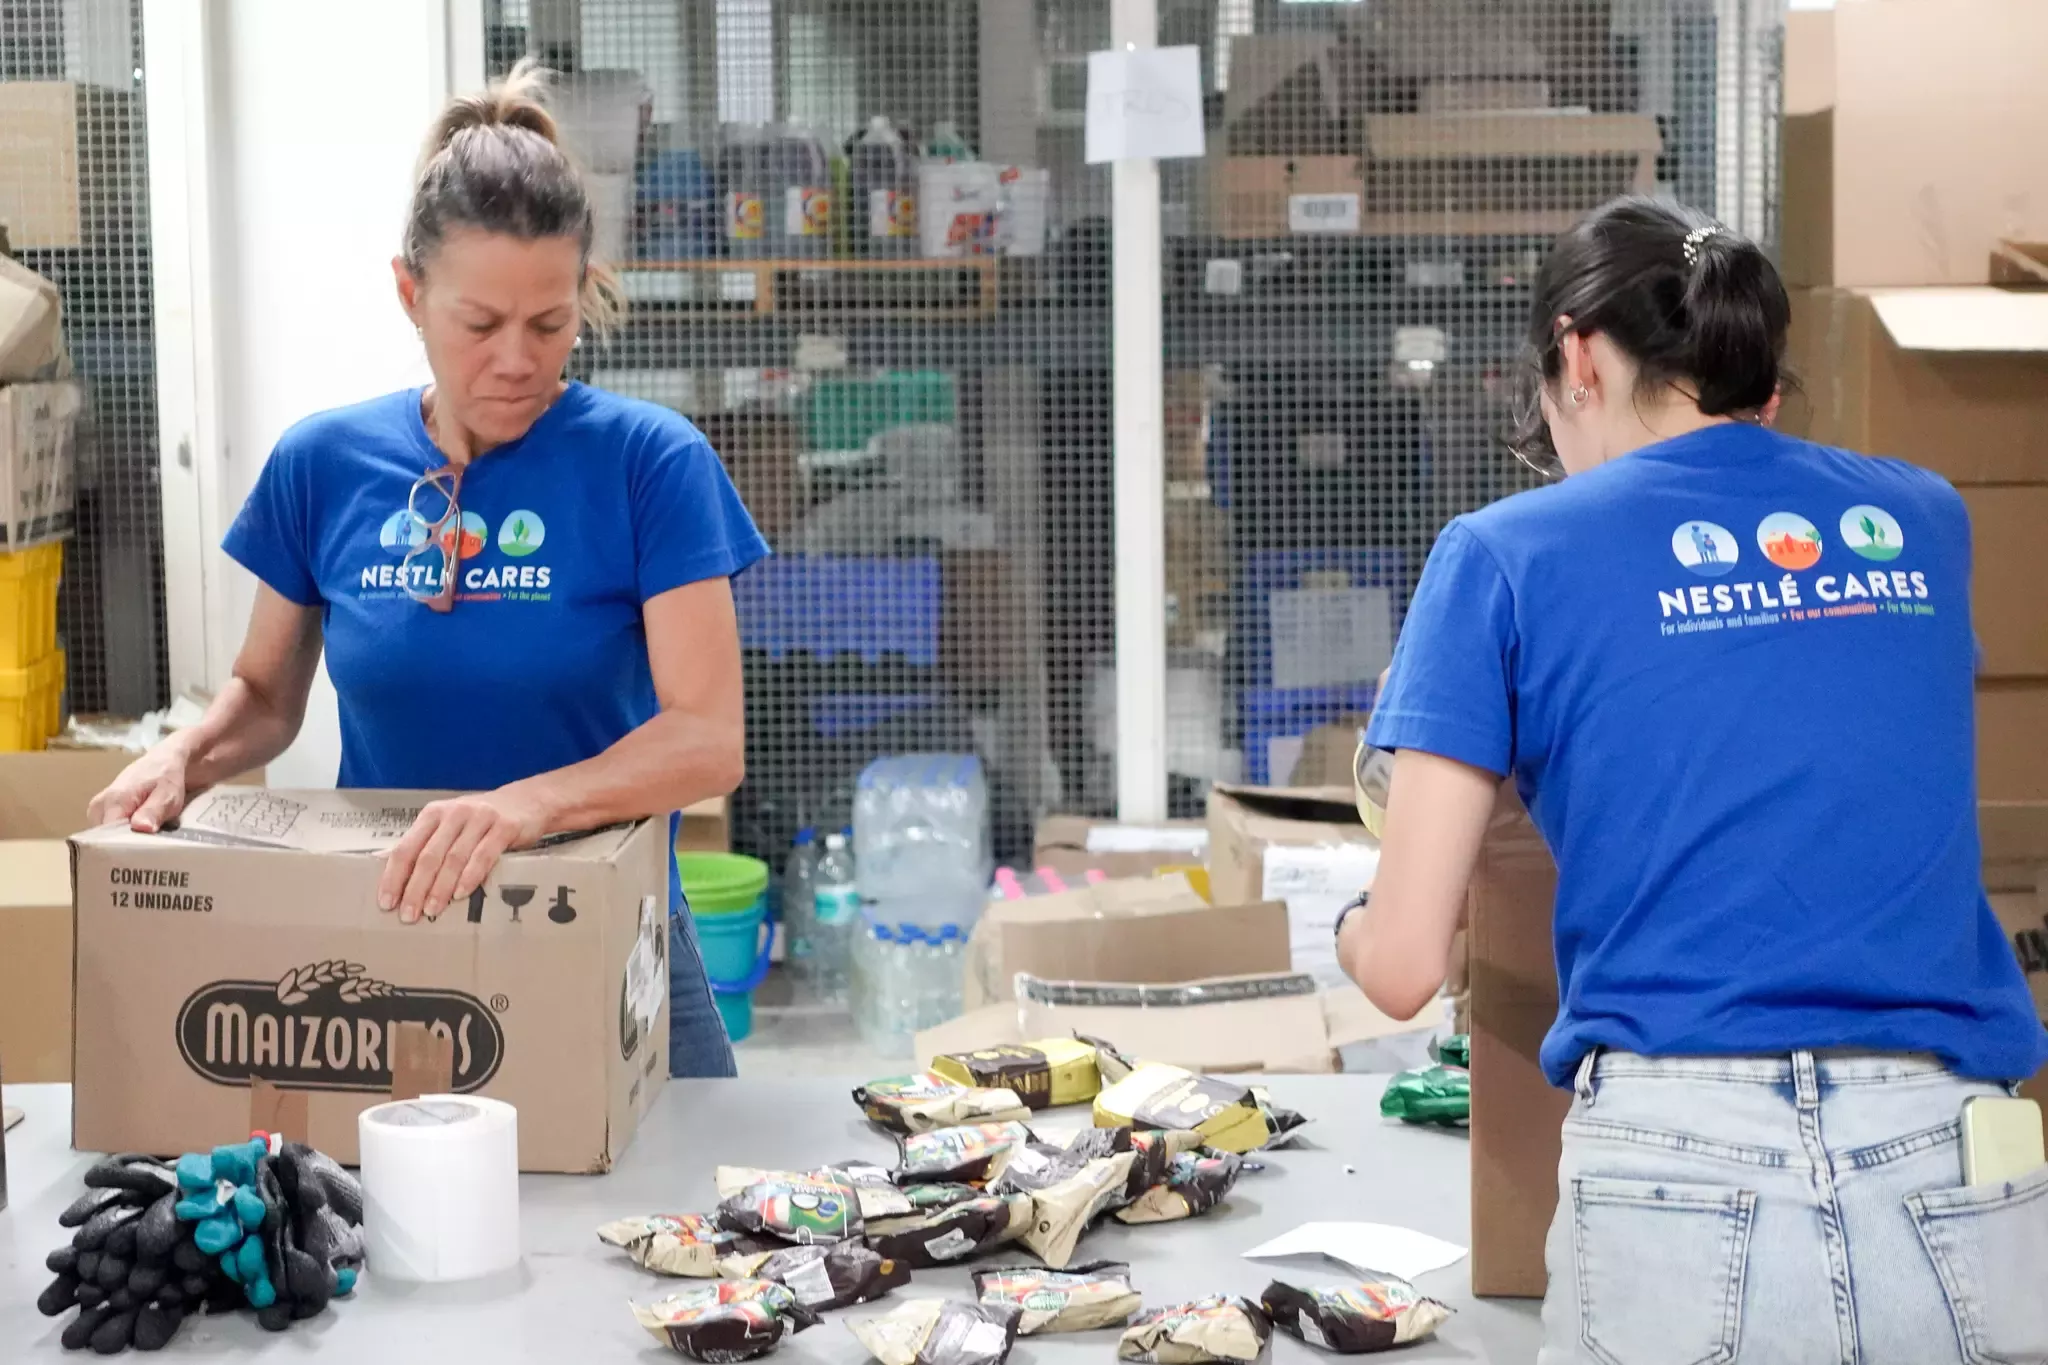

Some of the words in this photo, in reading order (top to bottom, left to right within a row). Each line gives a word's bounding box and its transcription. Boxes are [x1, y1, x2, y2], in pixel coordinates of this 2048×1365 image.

[465, 566, 551, 589] CARES
[1658, 573, 1801, 617] NESTLÉ
[1815, 570, 1928, 602] CARES
[1661, 621, 1675, 636] For
[1677, 616, 1724, 634] individuals
[1727, 614, 1743, 628] and
[1790, 608, 1804, 621] For
[110, 867, 190, 888] CONTIENE
[110, 889, 130, 908] 12
[134, 891, 214, 912] UNIDADES
[205, 1002, 472, 1076] MAIZORIS
